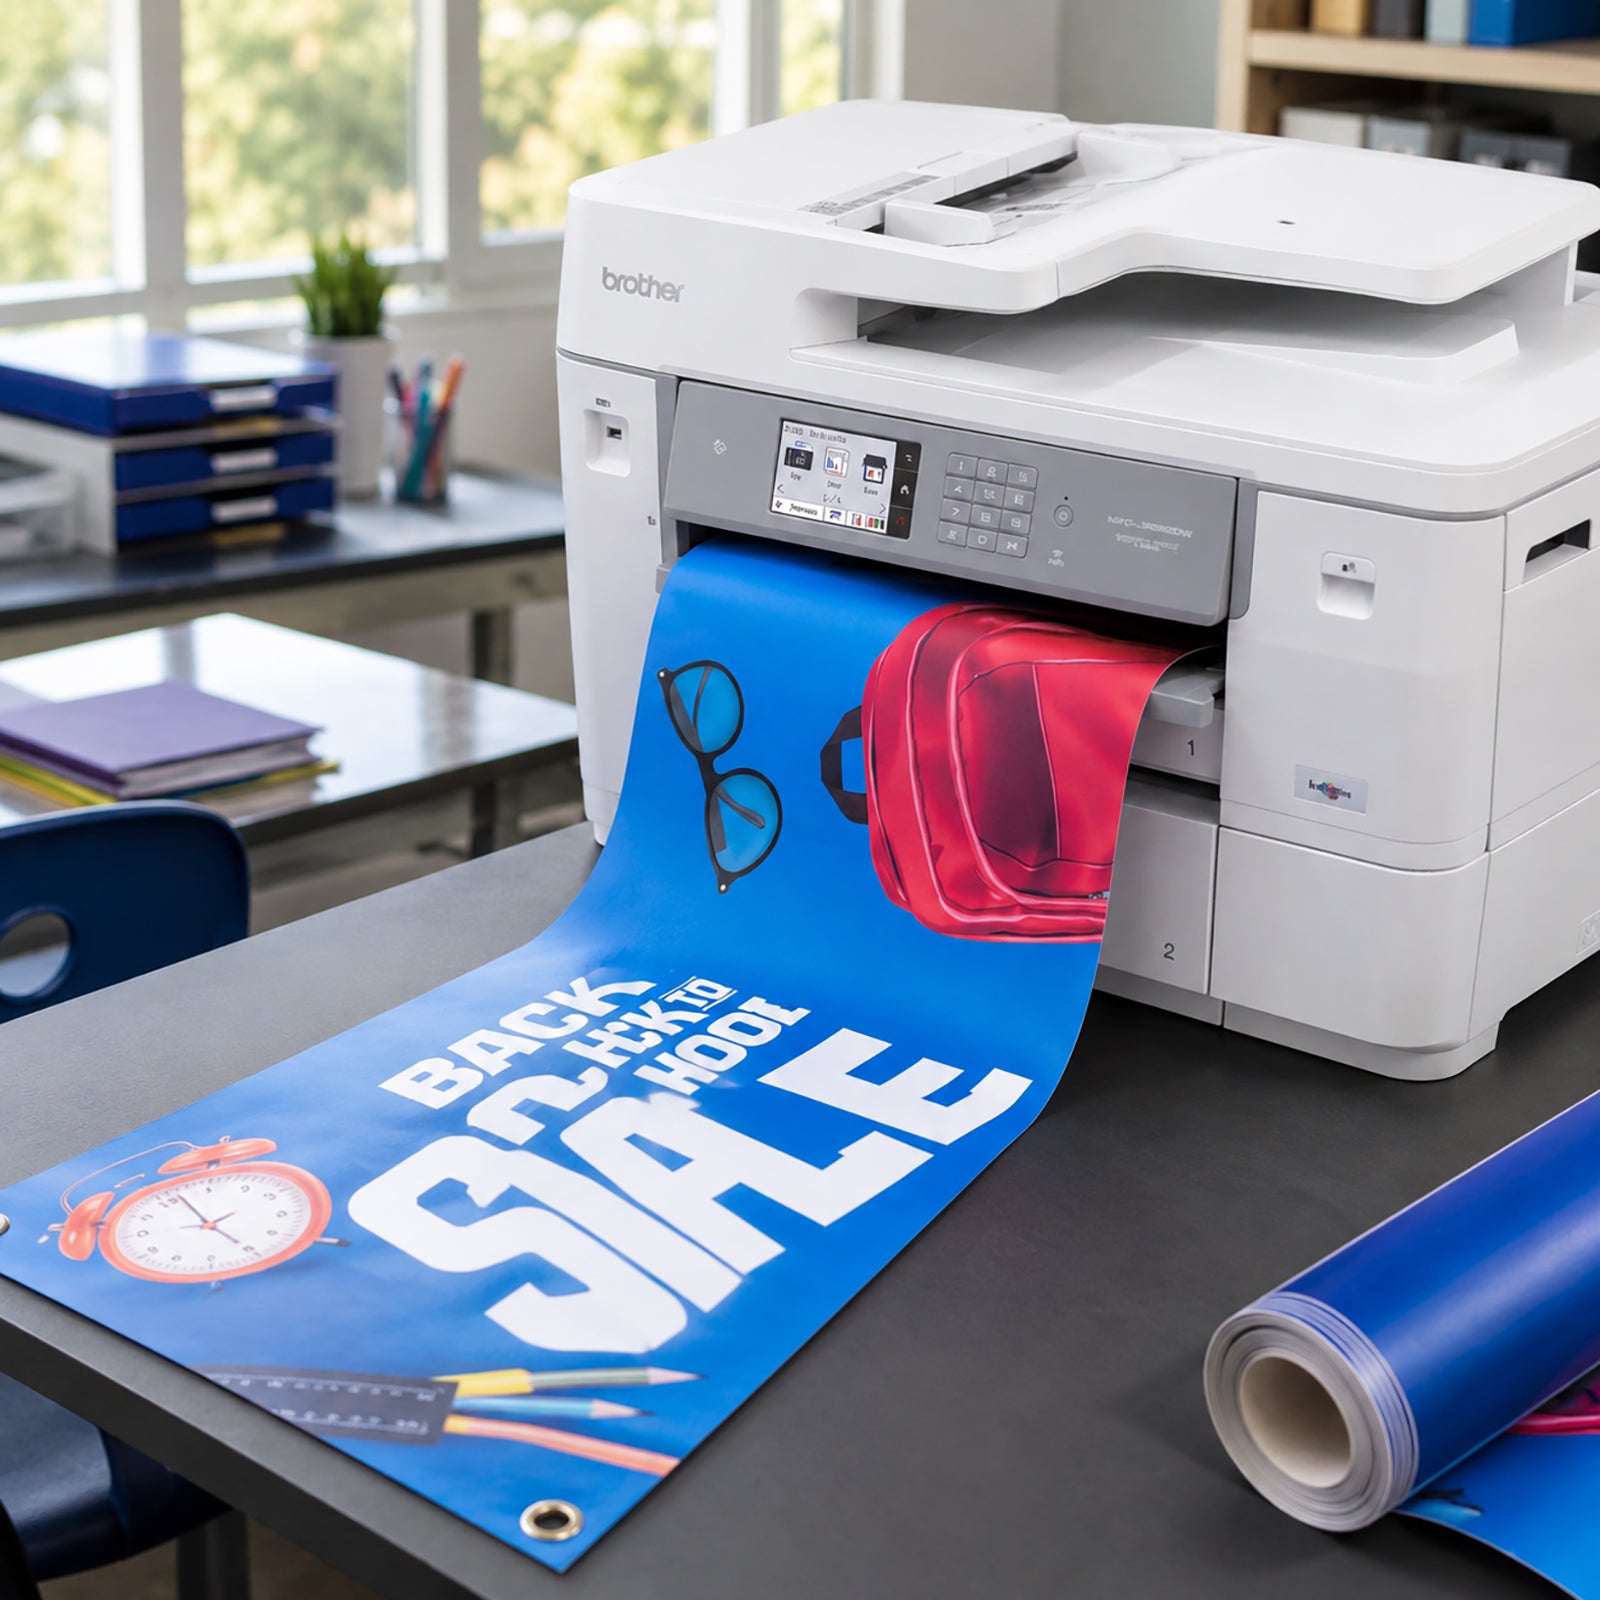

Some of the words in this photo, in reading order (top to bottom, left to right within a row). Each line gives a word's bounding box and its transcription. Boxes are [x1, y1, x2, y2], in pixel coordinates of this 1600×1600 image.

[602, 266, 685, 303] brother
[1187, 739, 1195, 756] 1
[1163, 942, 1176, 961] 2
[664, 978, 733, 1007] TO
[378, 976, 657, 1109] BACK
